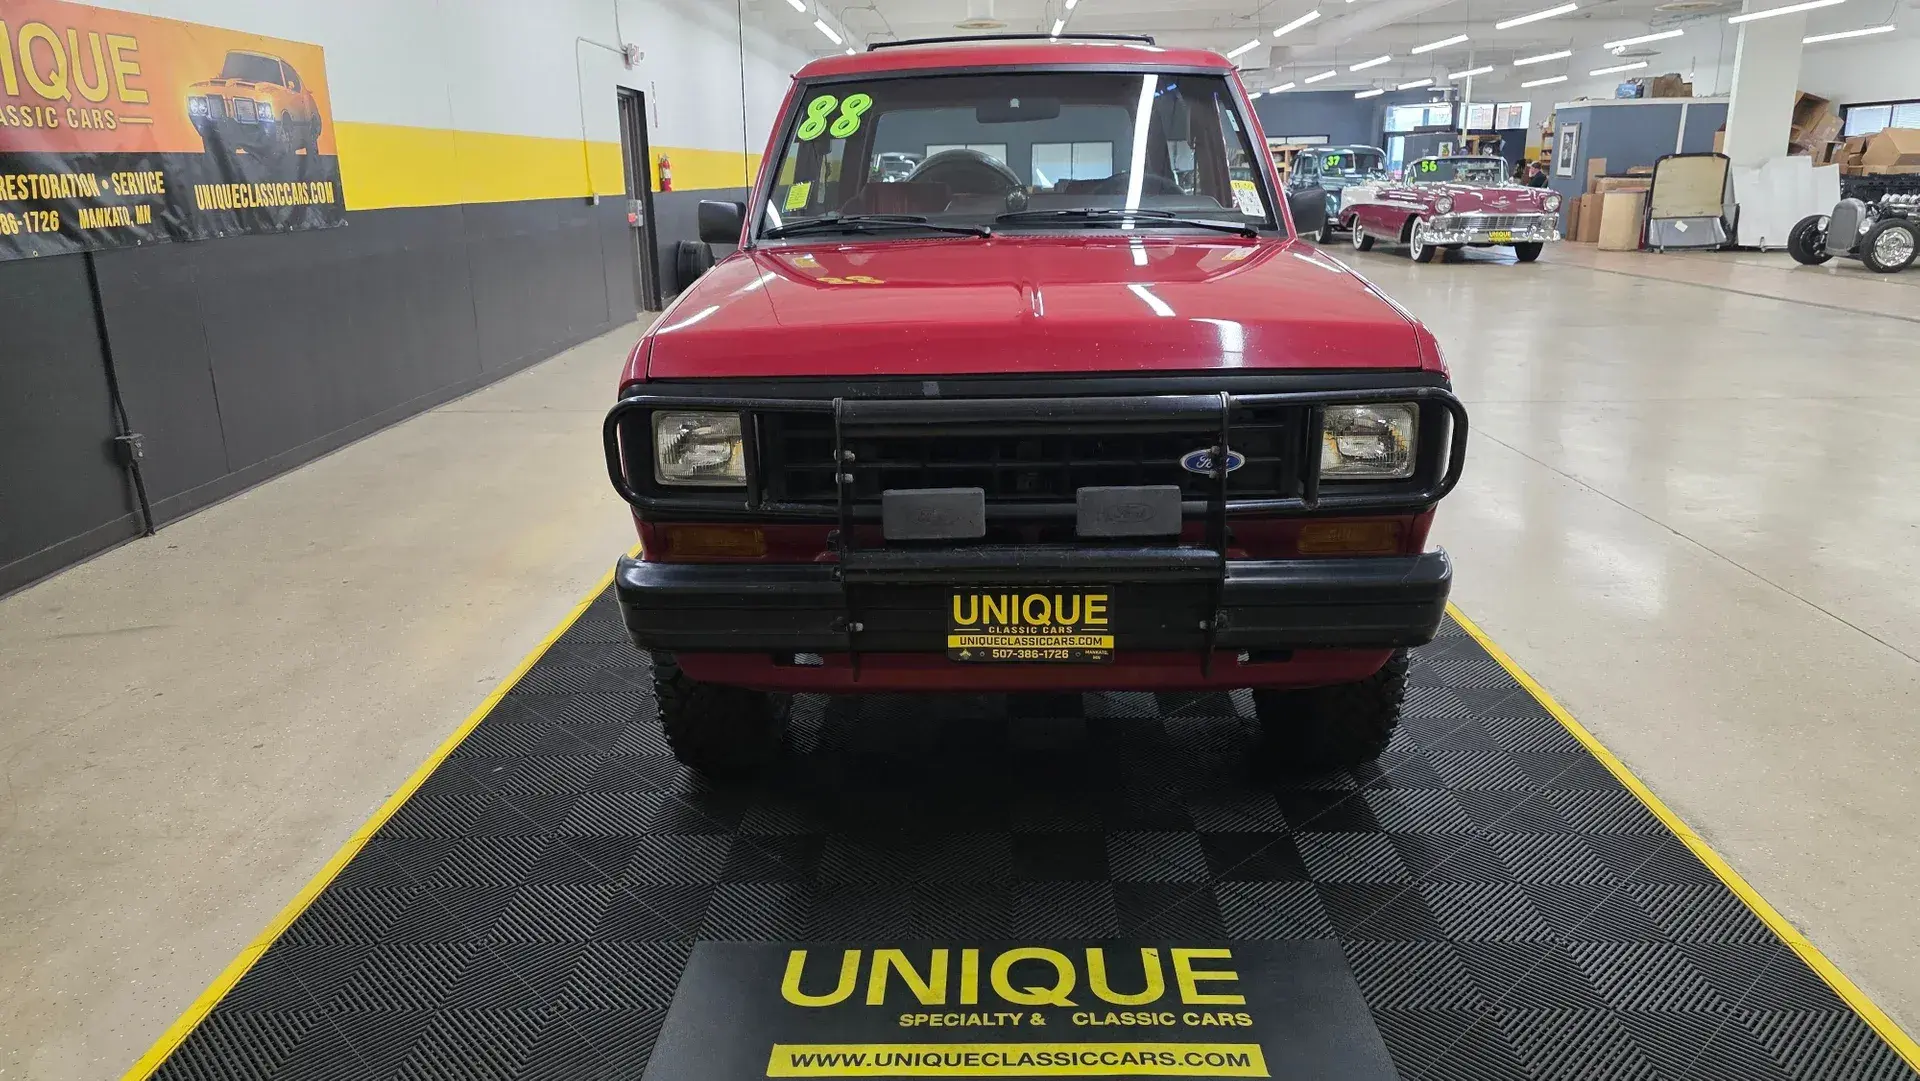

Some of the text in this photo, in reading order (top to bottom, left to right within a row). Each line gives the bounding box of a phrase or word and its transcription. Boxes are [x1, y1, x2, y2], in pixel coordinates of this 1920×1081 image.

[66, 107, 117, 130] CARS
[797, 93, 873, 141] 88
[1327, 155, 1340, 167] 37
[1421, 160, 1437, 173] 56
[0, 171, 165, 200] RESTORATION SERVICE
[194, 182, 335, 210] UNIQUECLASSICCARS.COM
[78, 206, 135, 229] MANKATO,
[135, 204, 151, 224] MN
[953, 594, 1108, 626] UNIQUE
[988, 626, 1073, 634] CLASSIC CARS
[959, 636, 1103, 646] UNIQUECLASSICCARS.COM
[992, 649, 1069, 659] 507-386-1726
[780, 947, 1246, 1007] UNIQUE
[899, 1012, 1254, 1027] SPECIALTY & CLASSIC CARS
[790, 1051, 1251, 1068] WWW.UNIQUECLASSICCARS.COM
